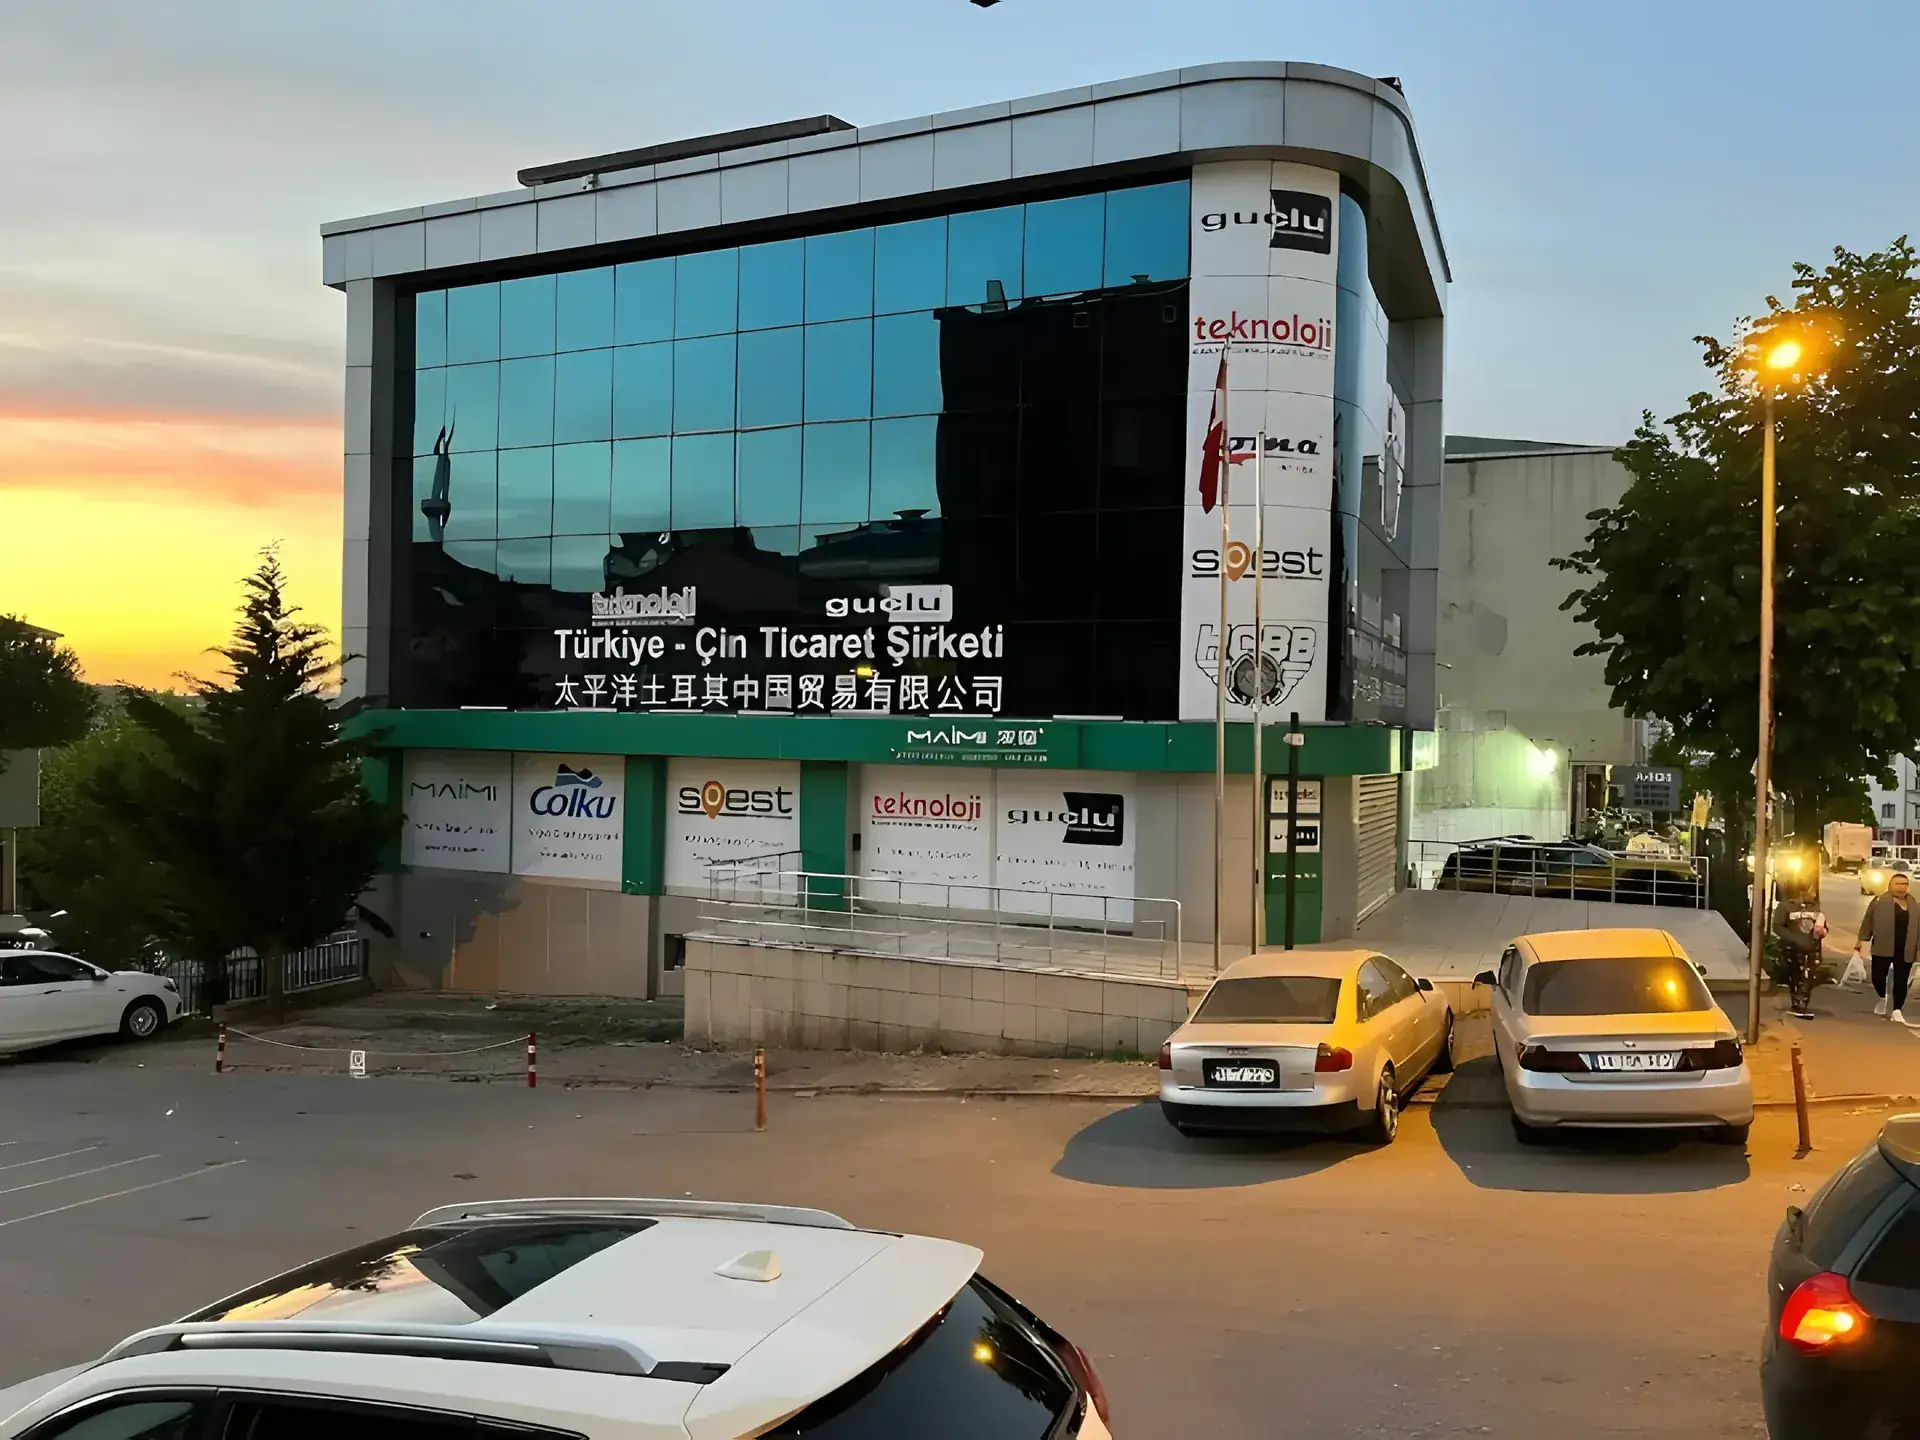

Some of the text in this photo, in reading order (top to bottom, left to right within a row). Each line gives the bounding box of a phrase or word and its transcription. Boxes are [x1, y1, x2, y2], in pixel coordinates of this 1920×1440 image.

[1195, 311, 1332, 349] teknoloji
[554, 628, 665, 666] Türkiye
[695, 626, 747, 667] Çin
[759, 625, 875, 659] Ticaret
[886, 624, 1004, 667] Şirketi
[554, 673, 1003, 712] 太平洋土耳其中国贸易有限公司
[873, 792, 982, 821] teknoloji
